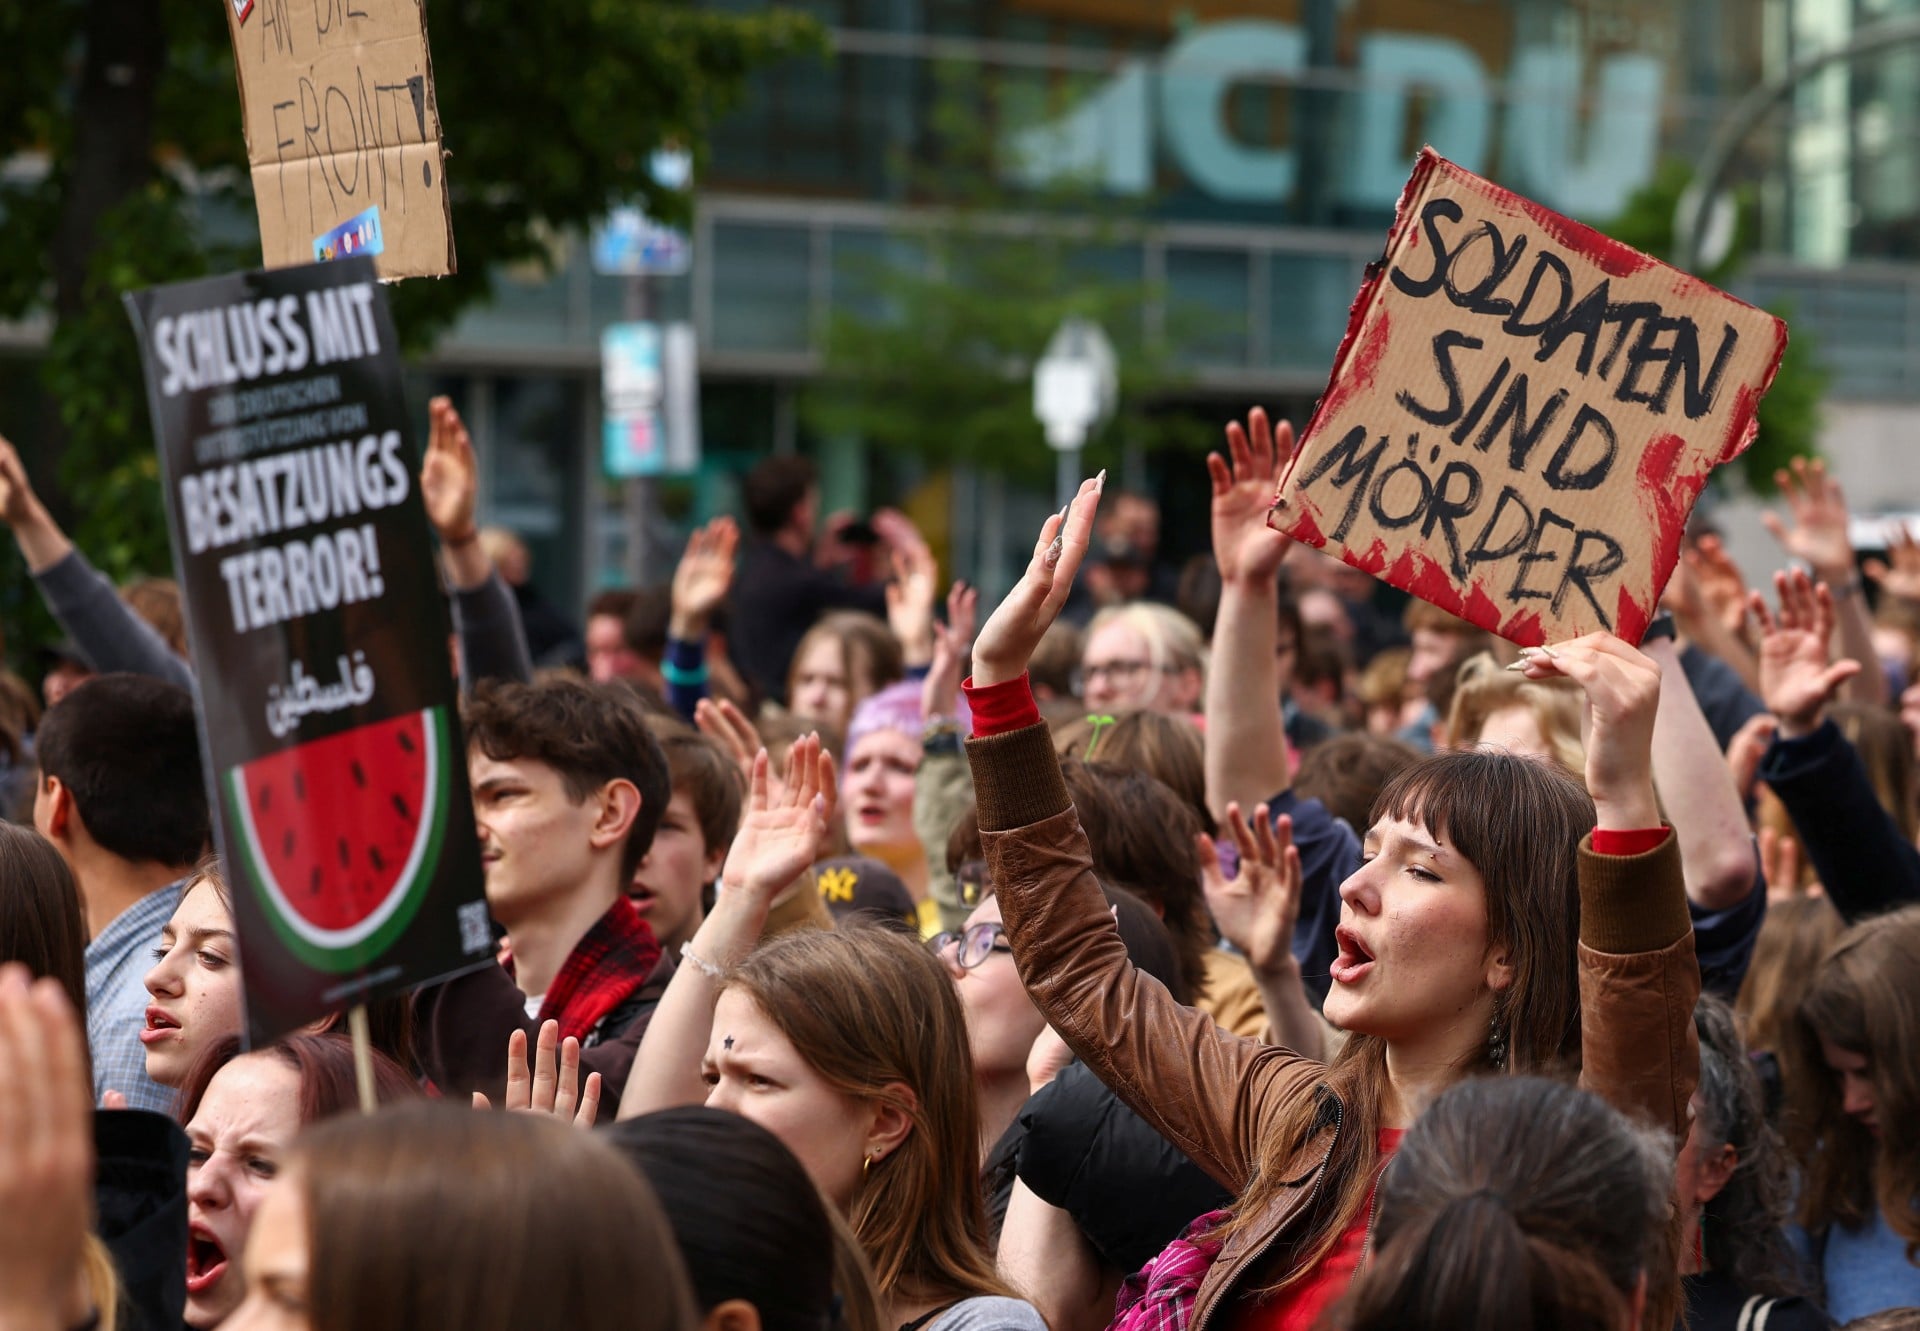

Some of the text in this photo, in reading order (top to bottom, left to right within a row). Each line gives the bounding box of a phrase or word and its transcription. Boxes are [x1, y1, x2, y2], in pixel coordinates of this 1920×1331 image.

[273, 64, 432, 234] FRONT!
[1162, 20, 1662, 217] CDU
[154, 281, 380, 396] SCHLUSS MIT
[1390, 198, 1739, 421] SOLDATEN
[1396, 329, 1620, 491] SIND
[180, 429, 410, 555] BESATZUNGS
[1297, 424, 1626, 631] MÖRDER
[220, 522, 385, 634] TERROR!
[266, 648, 375, 738] فلسطين
